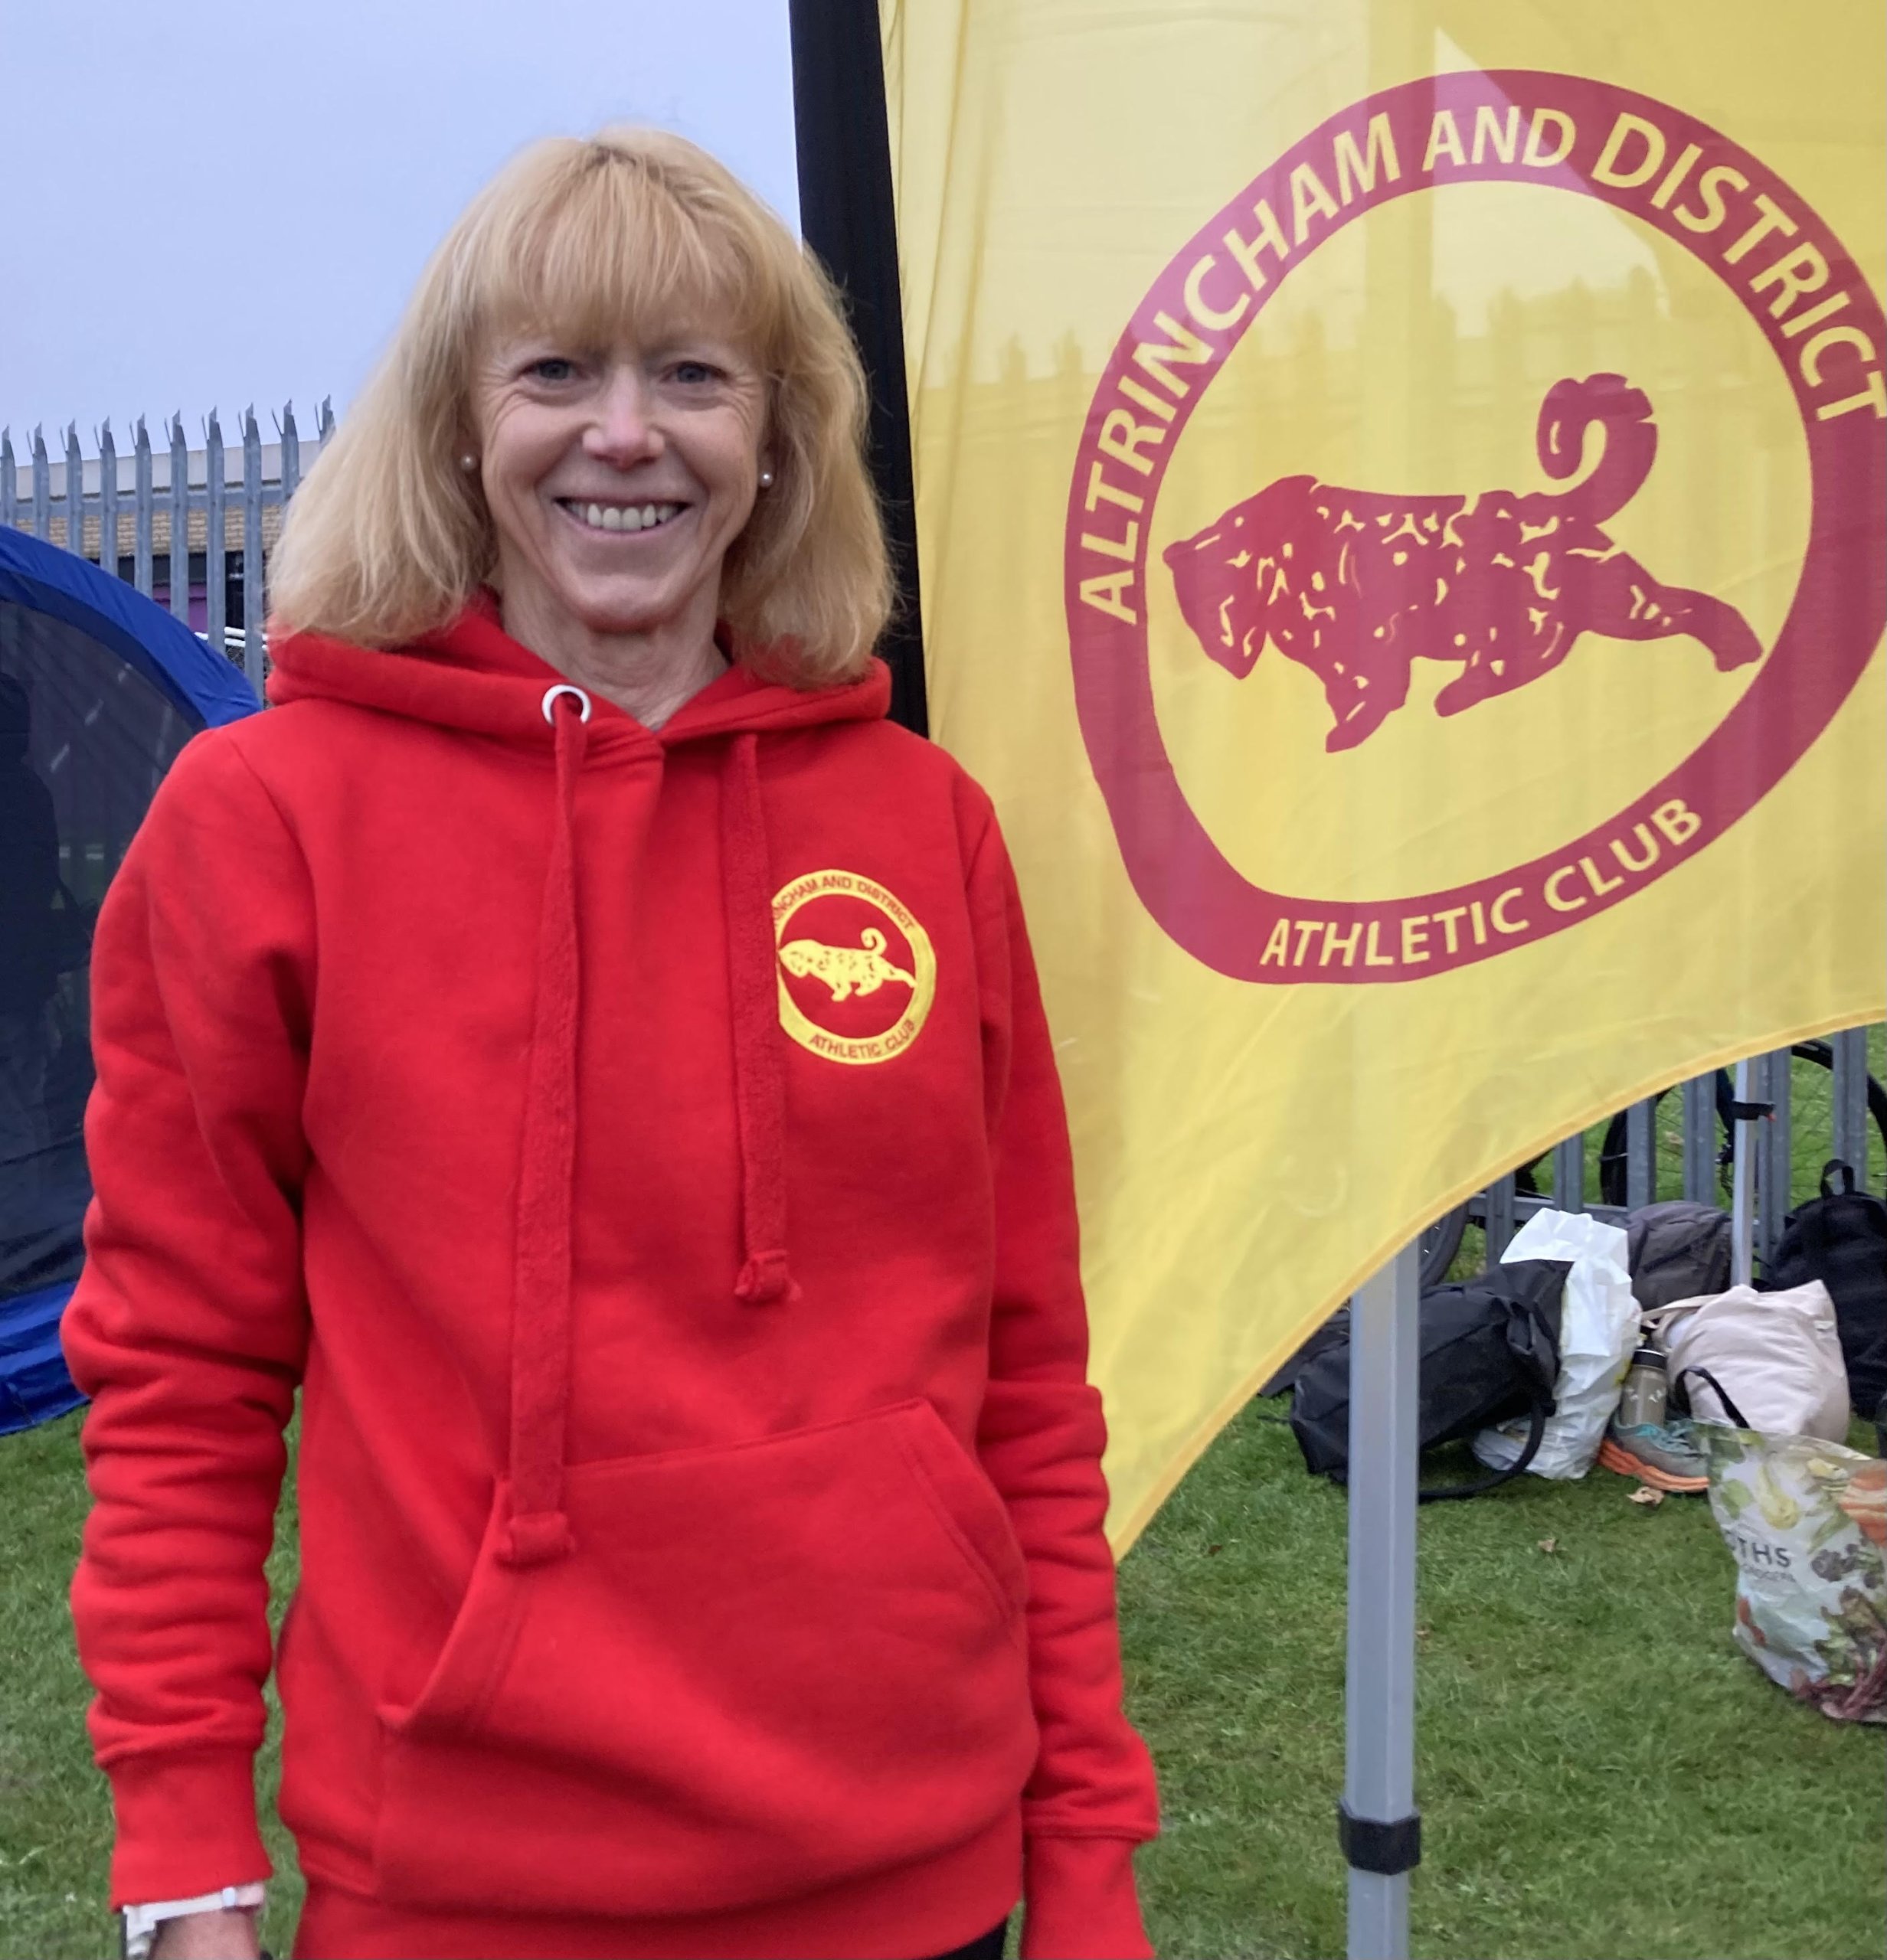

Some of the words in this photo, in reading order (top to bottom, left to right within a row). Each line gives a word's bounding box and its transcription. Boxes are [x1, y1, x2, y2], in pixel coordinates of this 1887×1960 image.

[1080, 111, 1401, 625] ALTRINCHAM
[1421, 104, 1576, 172] AND
[1591, 112, 1887, 421] DISTRICT
[822, 875, 852, 890] AND
[857, 880, 915, 929] DISTRICT
[1260, 887, 1529, 966] ATHLETIC
[1544, 799, 1702, 912] CLUB
[809, 1034, 881, 1059] ATHLETIC
[885, 1019, 915, 1050] CLUB
